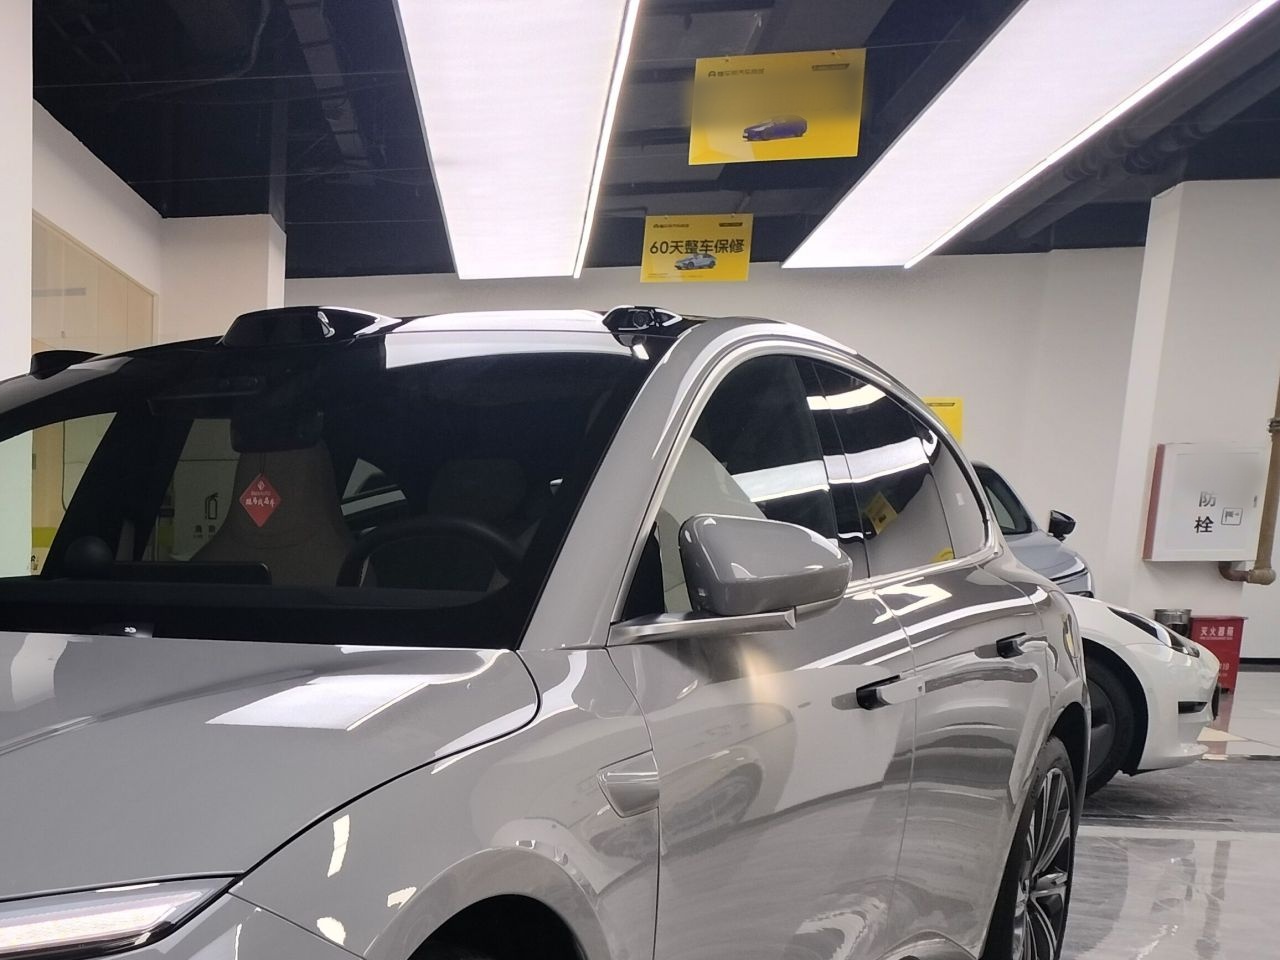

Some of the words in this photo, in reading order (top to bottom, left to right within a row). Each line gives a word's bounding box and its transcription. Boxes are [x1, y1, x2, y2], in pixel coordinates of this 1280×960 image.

[650, 239, 744, 254] 60天整车保修
